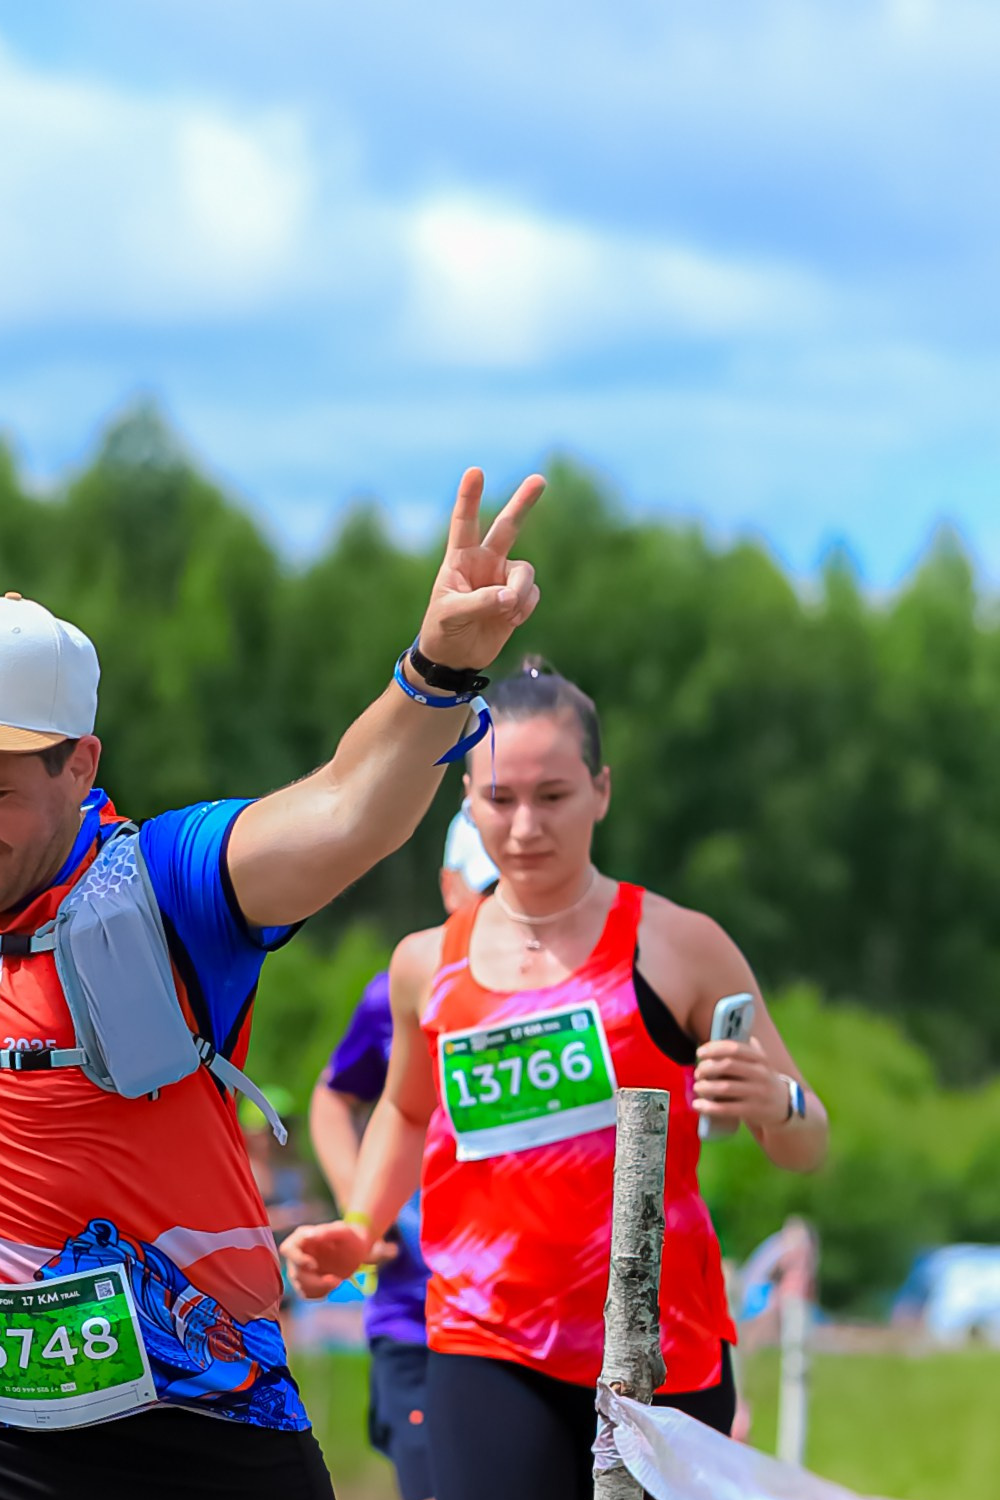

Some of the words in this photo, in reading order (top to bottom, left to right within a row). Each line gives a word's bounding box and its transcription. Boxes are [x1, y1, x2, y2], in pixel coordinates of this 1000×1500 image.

[452, 1041, 593, 1107] 13766
[21, 1296, 33, 1306] 17
[38, 1293, 59, 1305] KM
[60, 1290, 80, 1301] TRAIL
